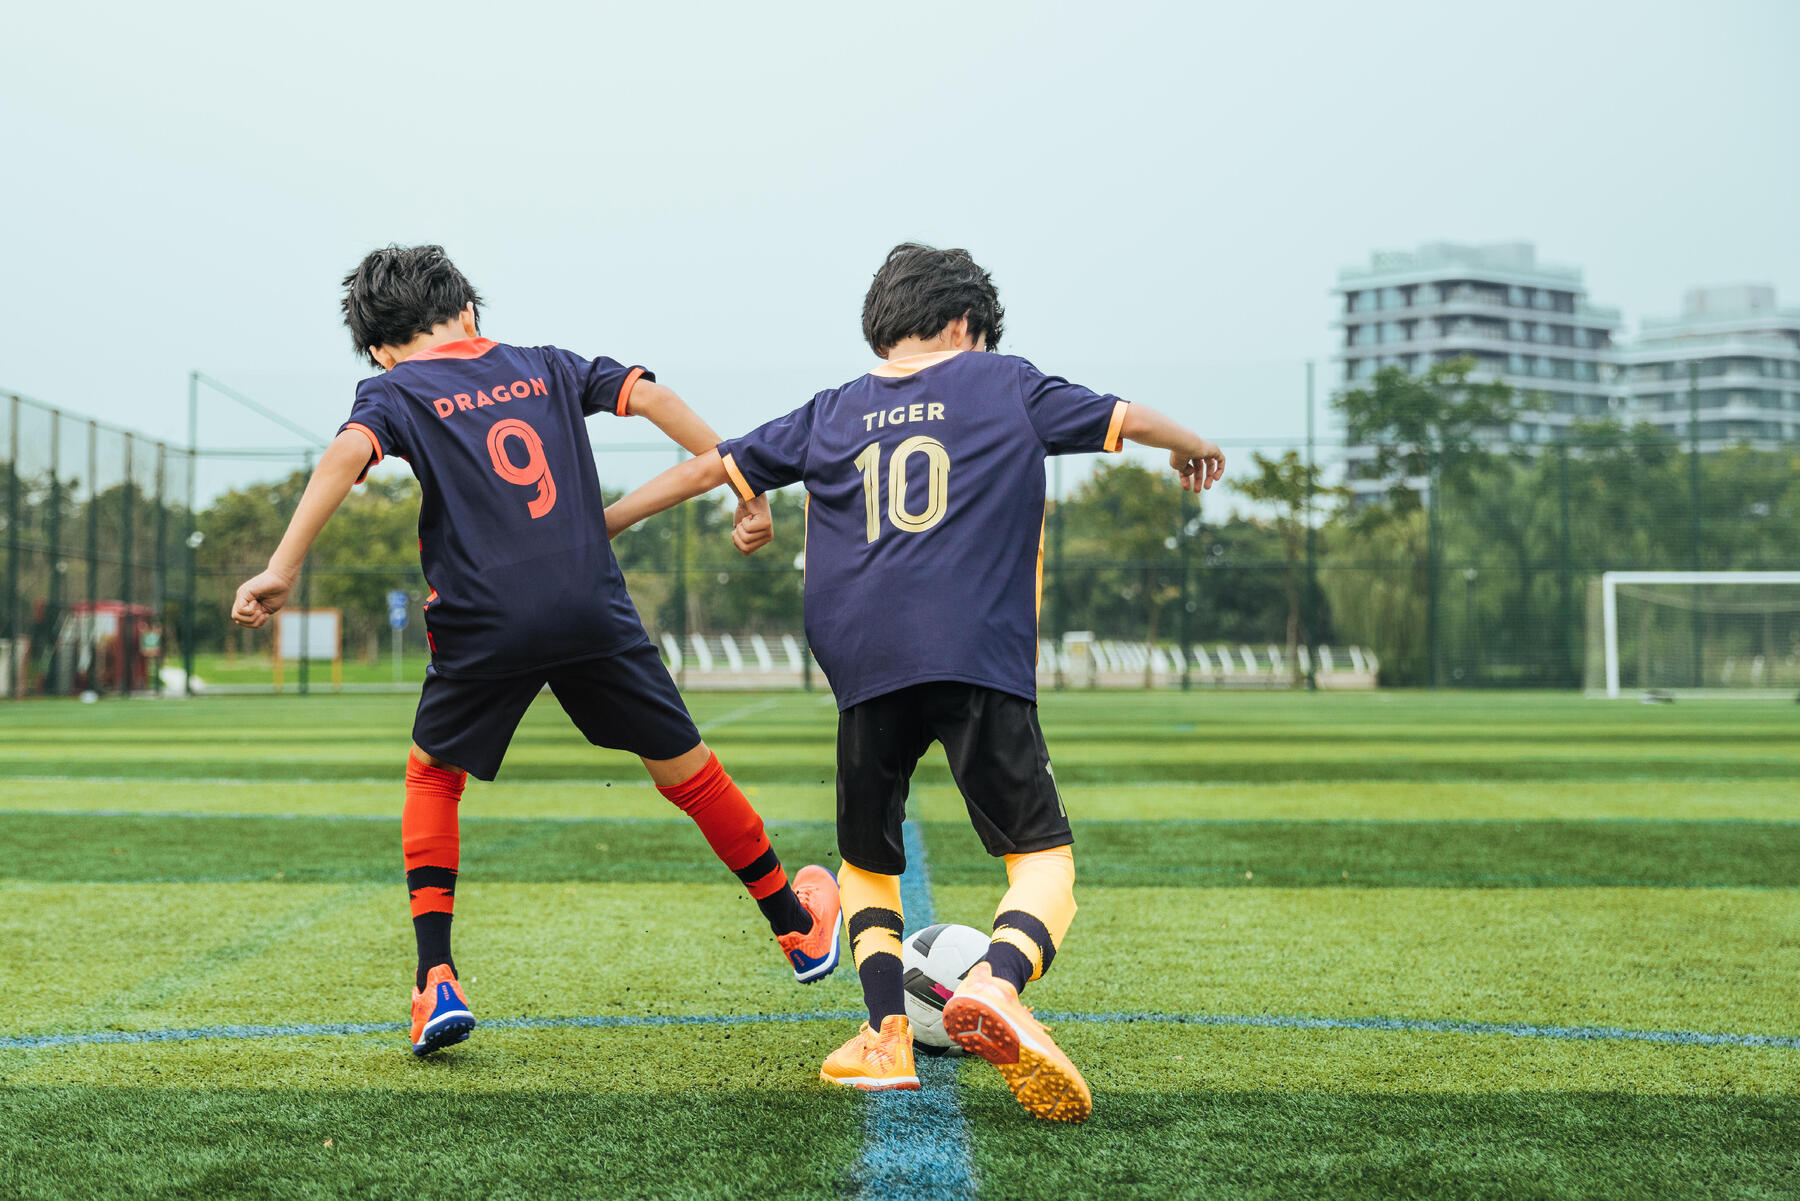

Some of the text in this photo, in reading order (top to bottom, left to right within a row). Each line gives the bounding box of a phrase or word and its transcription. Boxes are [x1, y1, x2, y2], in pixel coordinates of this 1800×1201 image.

[433, 377, 548, 418] DRAGON
[863, 402, 945, 431] TIGER
[486, 418, 557, 519] 9
[854, 435, 950, 544] 10
